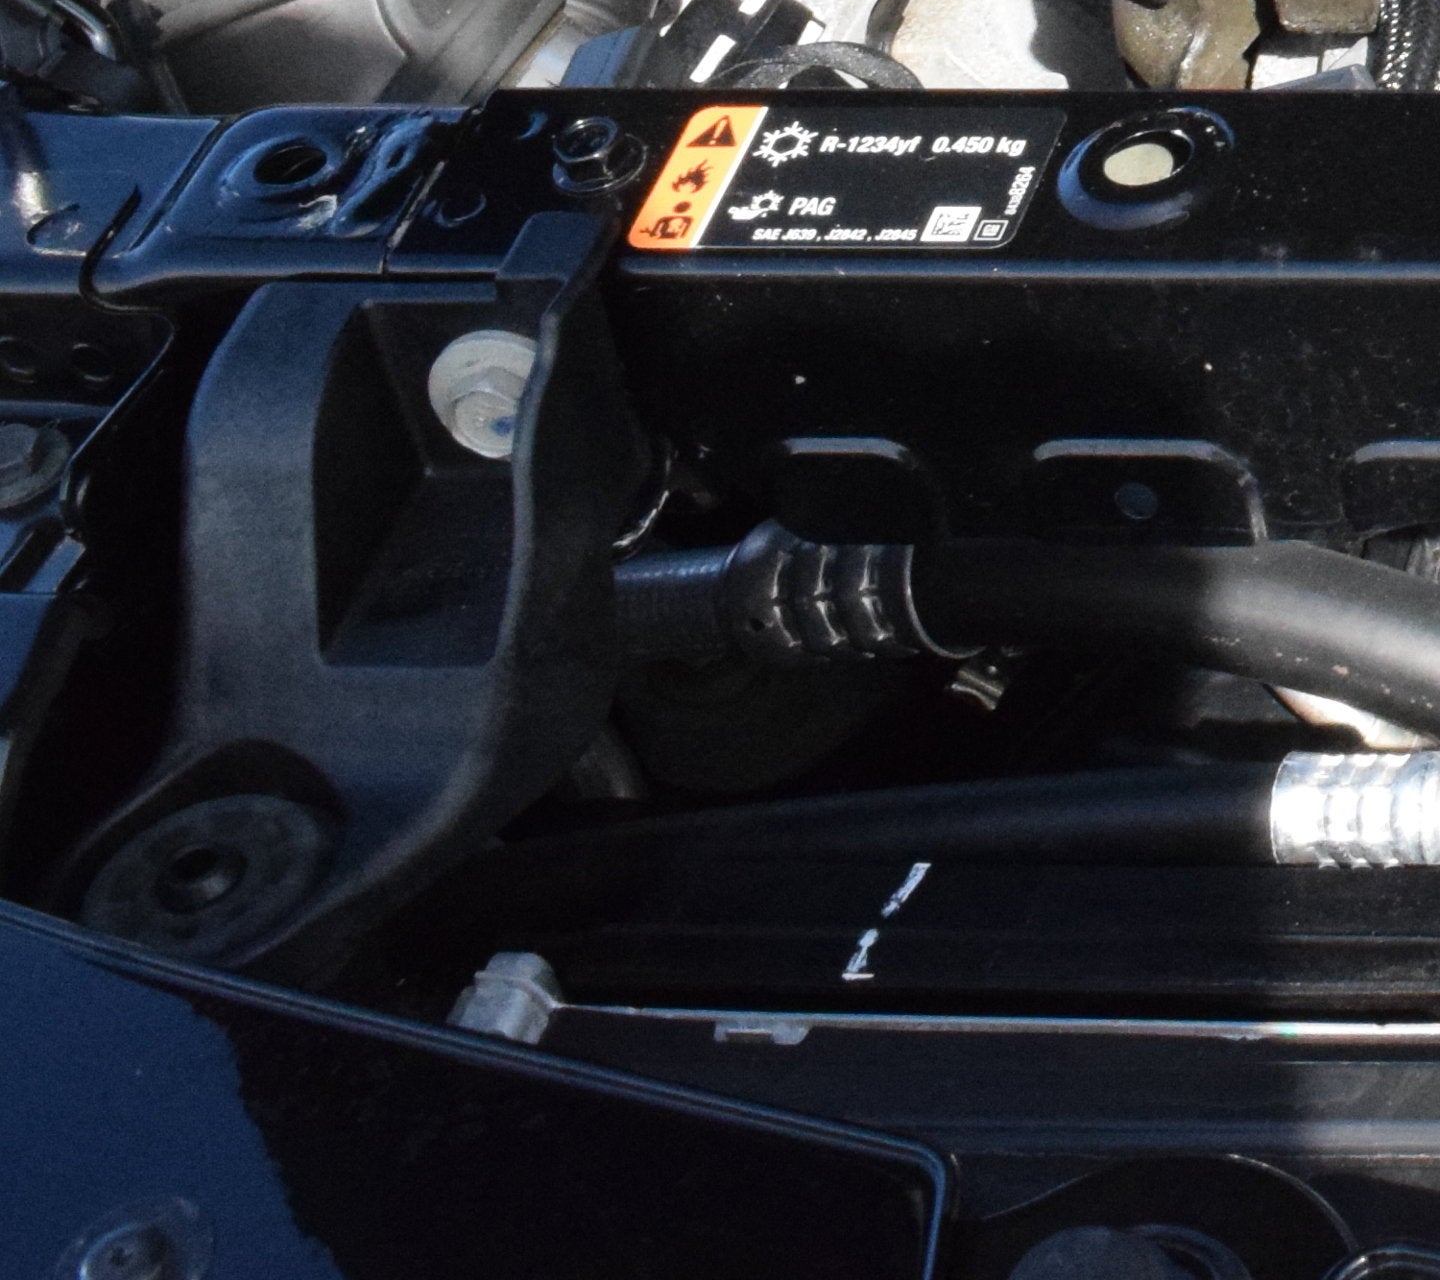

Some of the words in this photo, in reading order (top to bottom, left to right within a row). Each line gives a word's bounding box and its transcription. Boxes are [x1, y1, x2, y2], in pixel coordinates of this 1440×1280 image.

[819, 135, 922, 156] R-1234yf
[931, 136, 992, 154] 0.450
[995, 136, 1028, 157] kg
[788, 197, 837, 216] PAG
[752, 228, 781, 241] SAE
